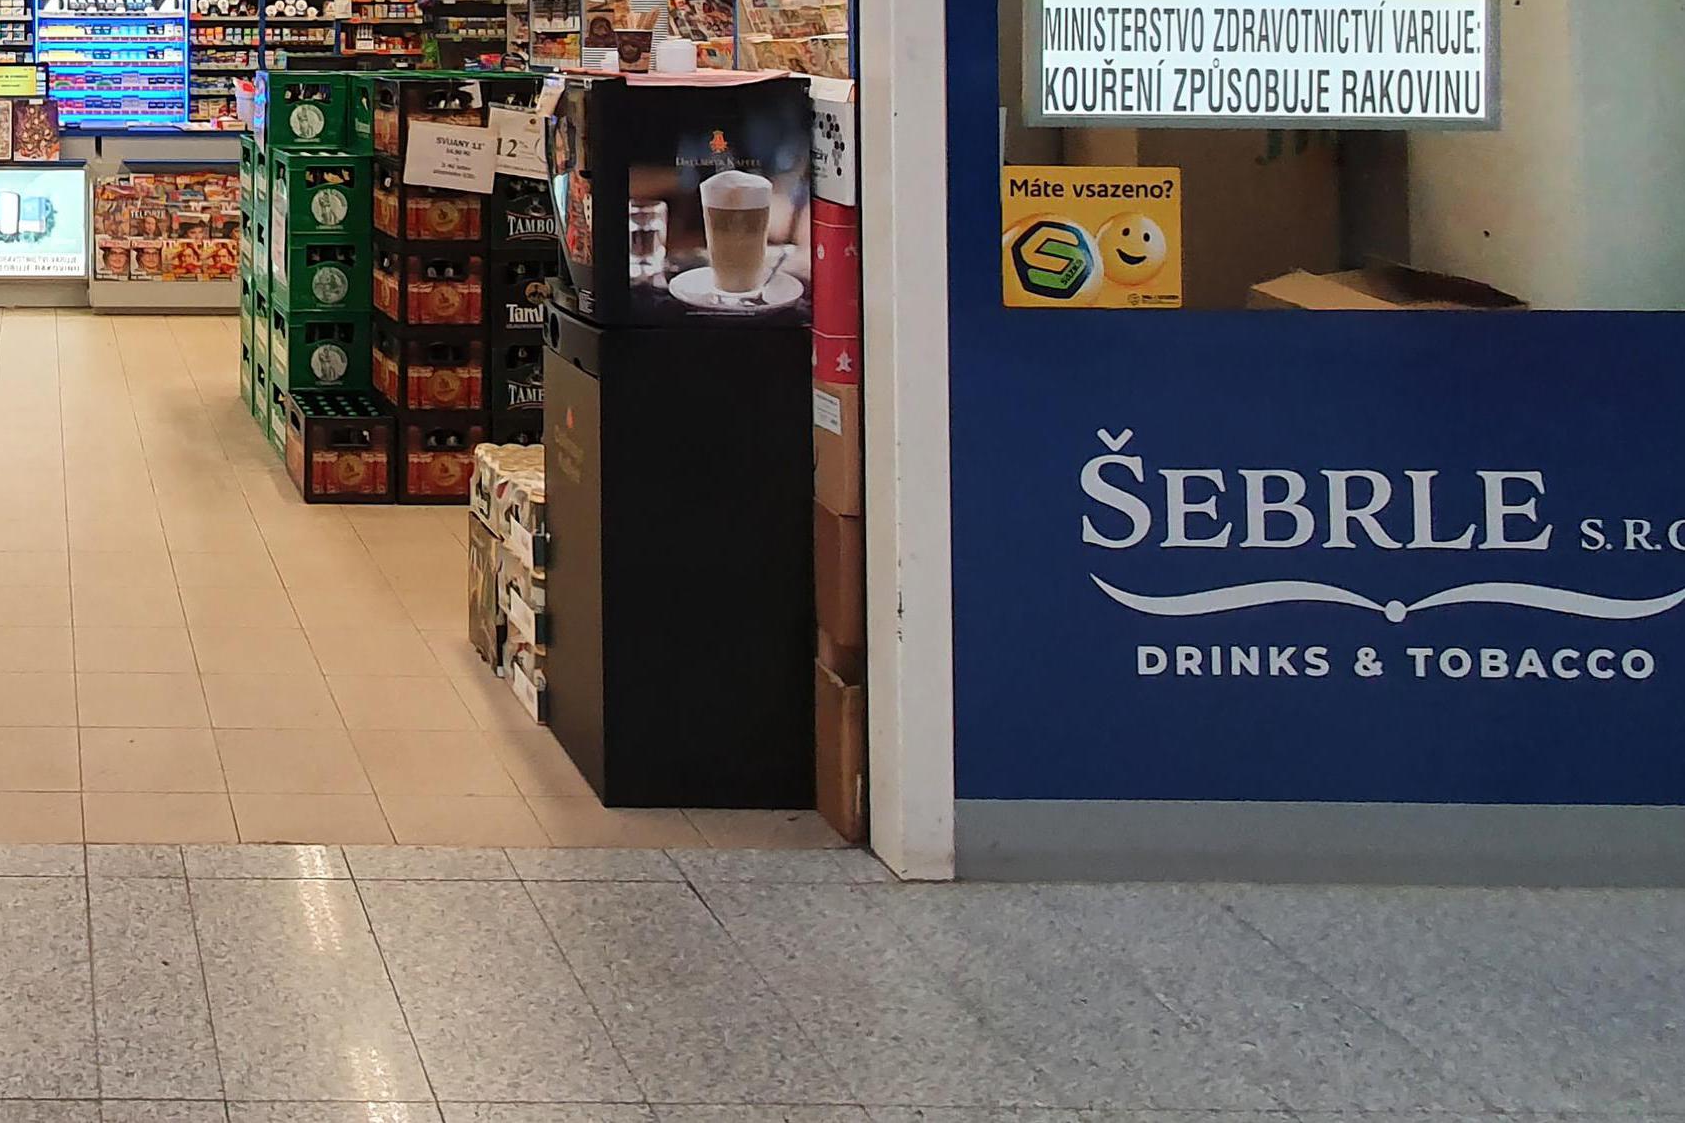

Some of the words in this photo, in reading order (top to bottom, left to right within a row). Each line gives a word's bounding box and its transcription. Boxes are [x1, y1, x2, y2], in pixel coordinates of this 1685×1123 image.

[1044, 7, 1205, 53] MINISTERSTVO
[1213, 1, 1387, 54] ZDRAVOTNICTVÍ
[1392, 9, 1481, 54] VARUJE:
[1045, 59, 1165, 112] KOUŘENÍ
[1173, 58, 1330, 113] ZPŮSOBUJE
[1341, 69, 1480, 115] RAKOVINU
[1009, 178, 1064, 197] Máte
[1072, 180, 1174, 199] vsazeno?
[1080, 428, 1553, 550] ŠEBRLE
[1137, 645, 1330, 676] DRINKS
[1354, 646, 1383, 677] &
[1406, 647, 1655, 679] TOBACCO
